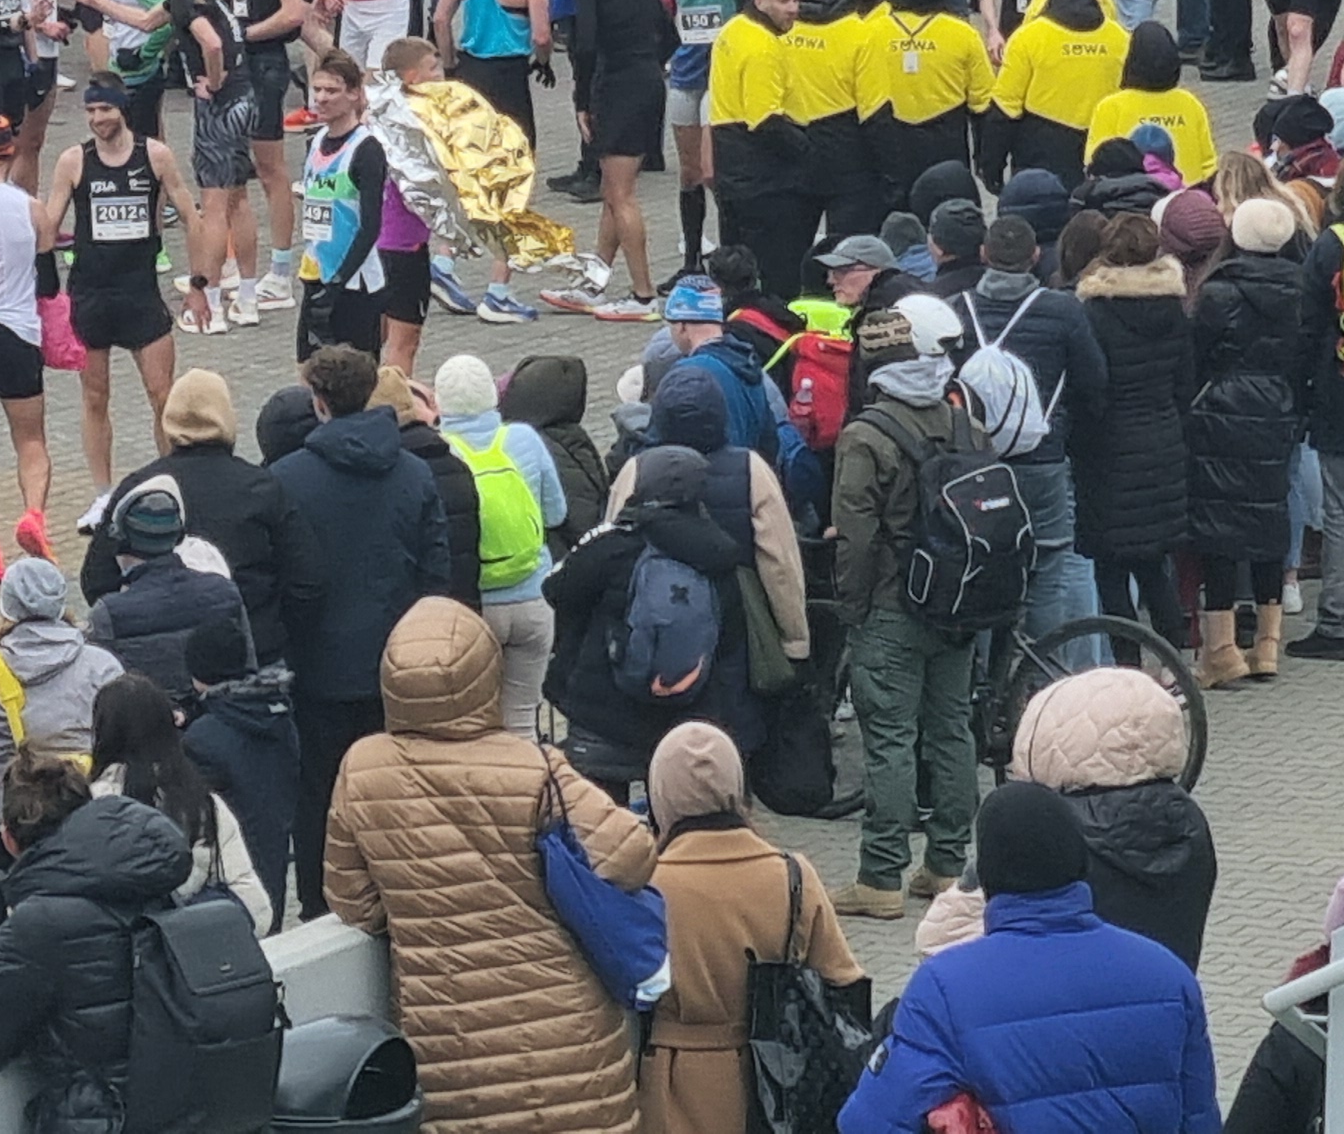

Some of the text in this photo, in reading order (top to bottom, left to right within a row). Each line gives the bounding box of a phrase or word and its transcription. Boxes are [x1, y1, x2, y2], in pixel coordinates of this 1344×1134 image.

[786, 35, 827, 51] SOWA
[889, 39, 937, 53] SOWA
[1061, 43, 1108, 56] SOWA
[98, 205, 138, 221] 2012
